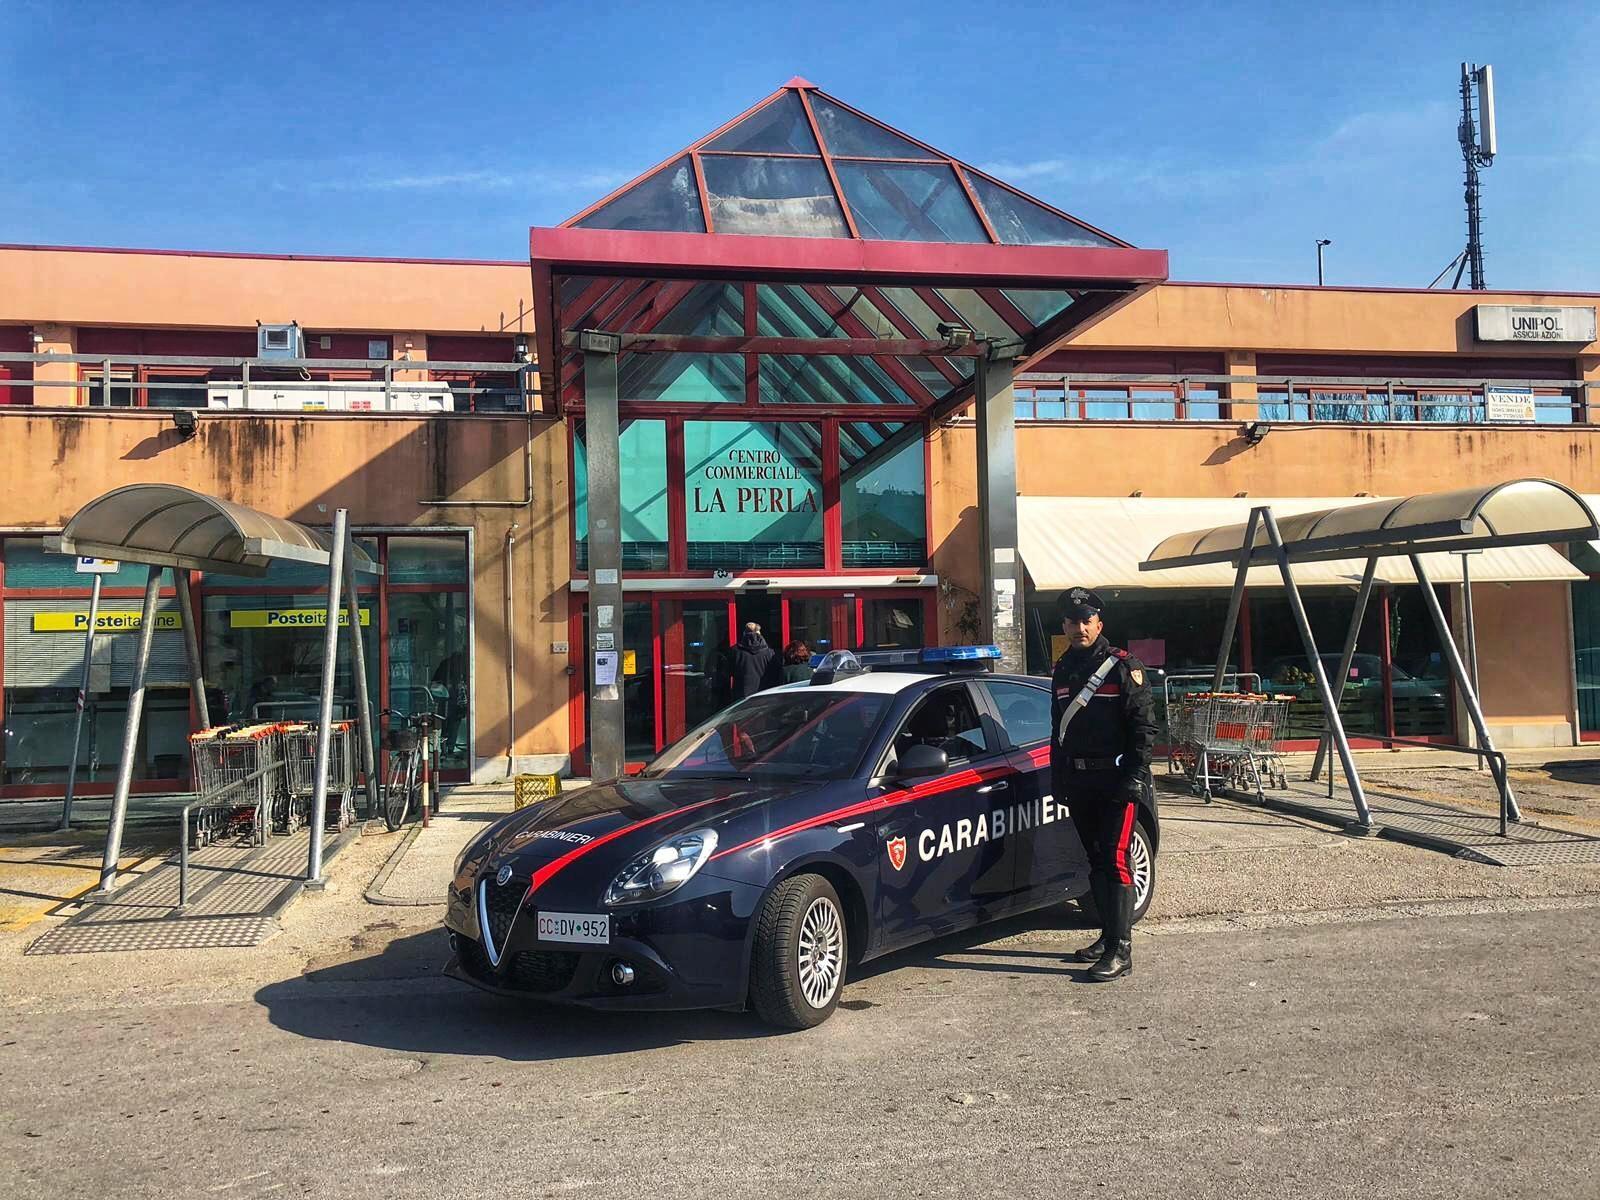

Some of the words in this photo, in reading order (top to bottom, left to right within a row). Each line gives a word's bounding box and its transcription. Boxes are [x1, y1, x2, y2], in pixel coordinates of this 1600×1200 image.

[1512, 317, 1563, 331] UNIPOL
[1513, 331, 1563, 339] ASSICUAZION
[1490, 395, 1531, 403] VENDE
[729, 449, 780, 463] CENTRO
[705, 465, 801, 480] COMMERCIALE
[694, 487, 726, 512] LA
[736, 487, 818, 512] PERLA
[74, 614, 175, 627] Psteitane
[918, 794, 1070, 862] CARABINIER
[515, 830, 595, 844] CARABINIERI
[539, 918, 553, 934] CC
[582, 921, 607, 938] 952
